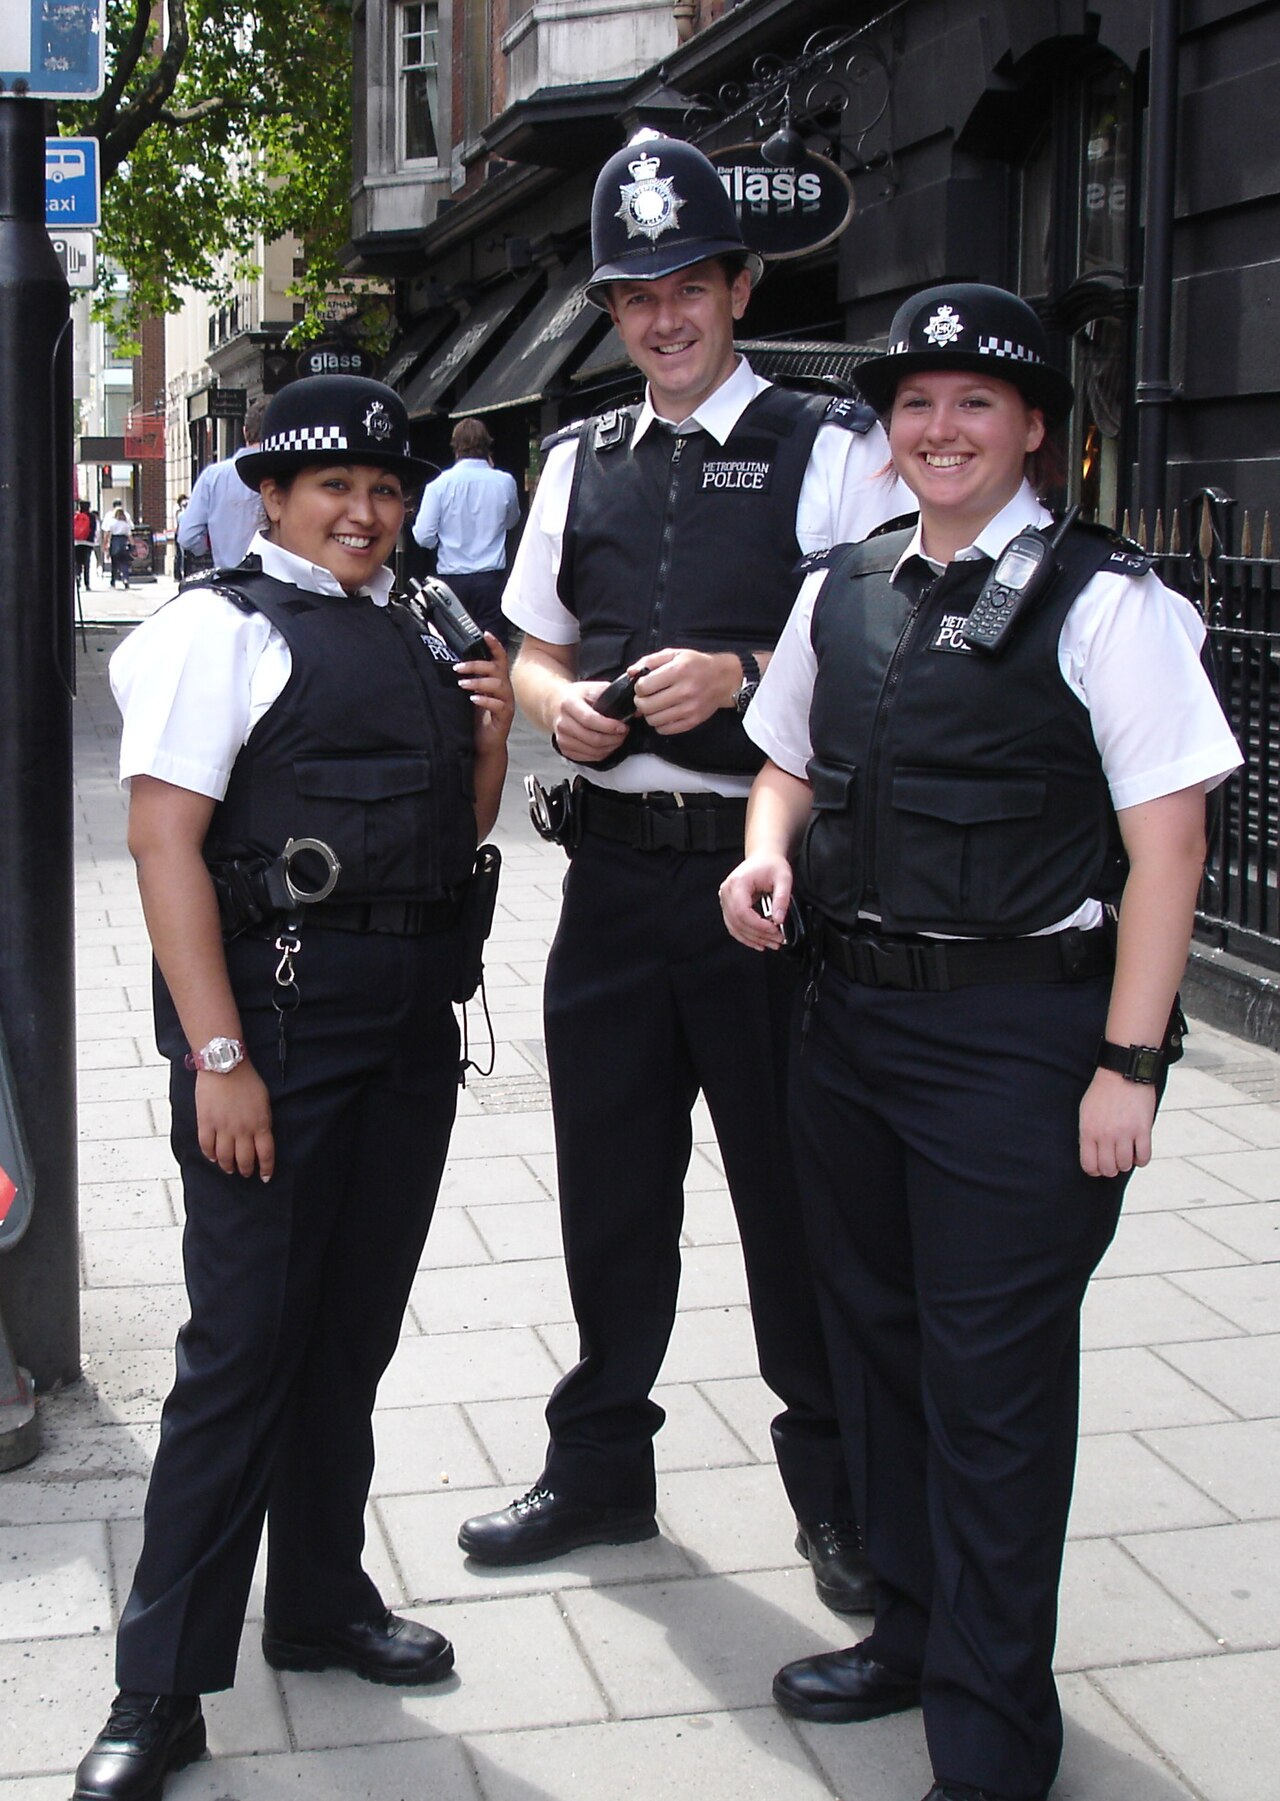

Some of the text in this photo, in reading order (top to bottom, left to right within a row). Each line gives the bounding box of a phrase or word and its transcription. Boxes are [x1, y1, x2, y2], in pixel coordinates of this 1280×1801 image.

[743, 166, 795, 174] Restaurant
[310, 352, 362, 373] glass
[702, 461, 770, 474] METROPOLITAN
[702, 471, 765, 489] POLICE
